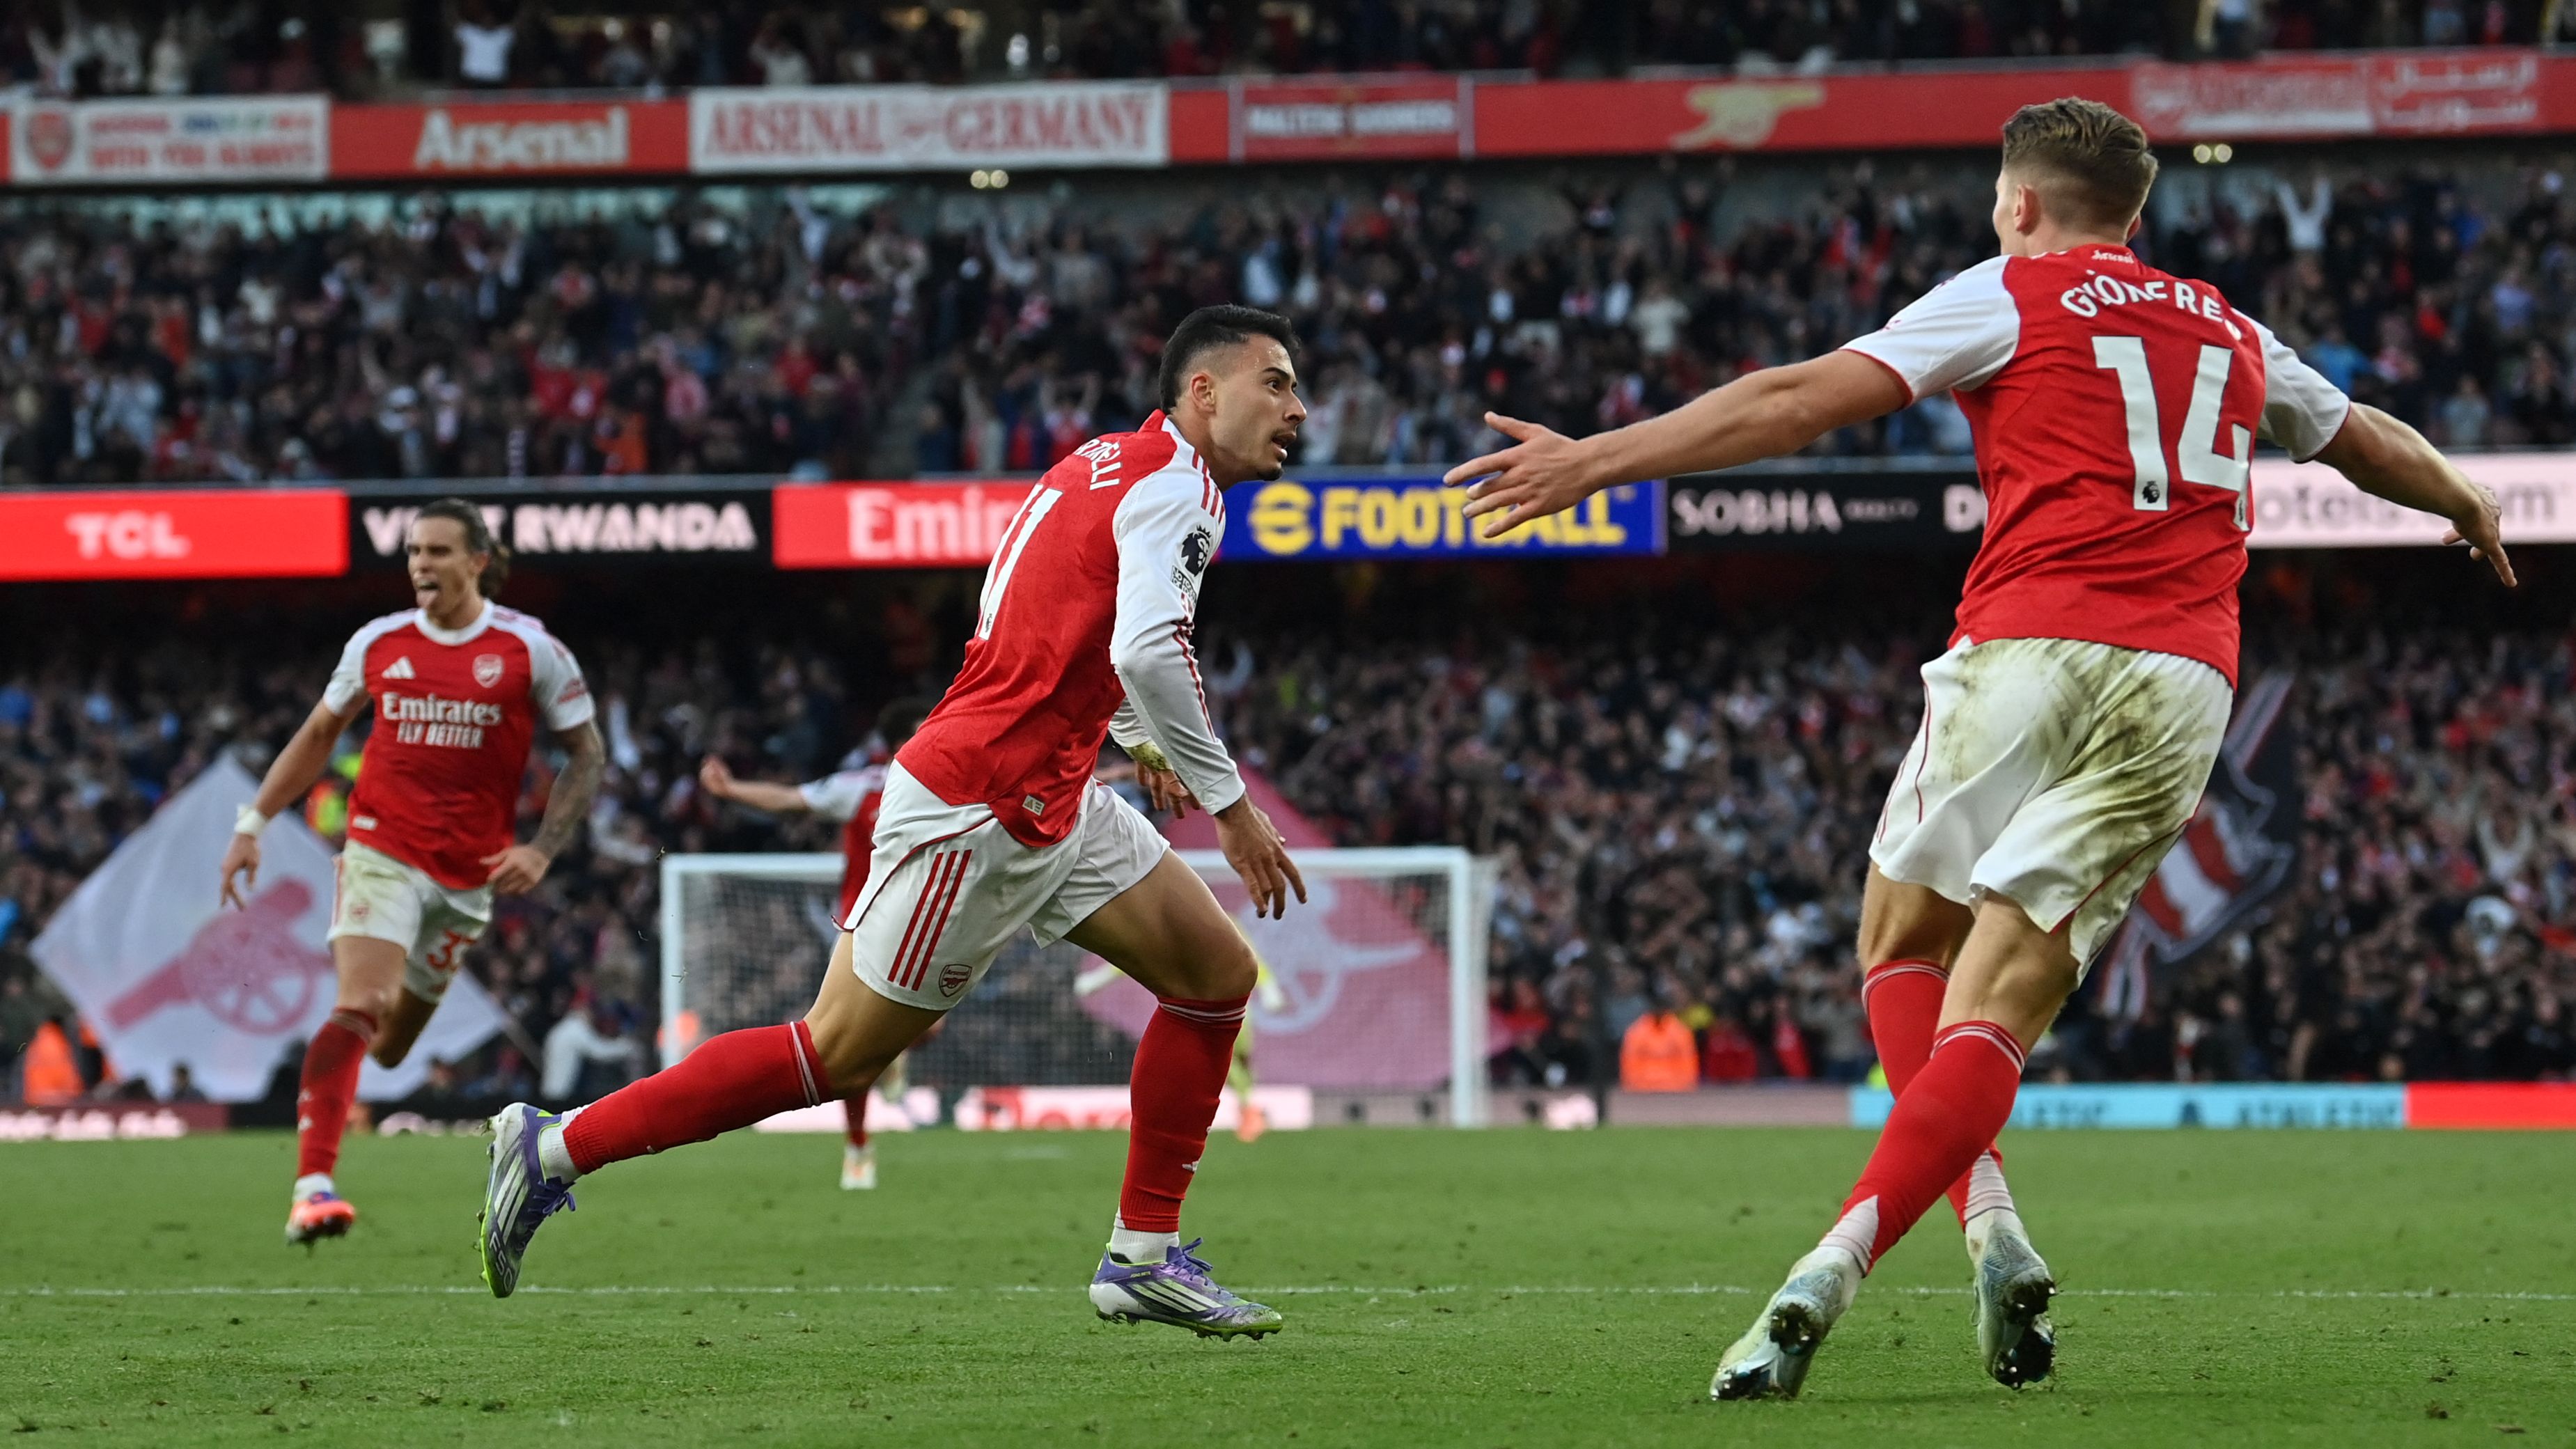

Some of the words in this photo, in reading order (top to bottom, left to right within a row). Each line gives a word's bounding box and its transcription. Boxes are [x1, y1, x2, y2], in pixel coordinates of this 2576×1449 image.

[414, 107, 629, 169] Arsenal
[706, 99, 885, 155] ARSENAL
[943, 91, 1154, 152] GERMANY
[2091, 336, 2251, 531] 14
[66, 510, 192, 558] TCL
[513, 501, 757, 554] RWANDA
[850, 486, 1022, 559] Emir
[1672, 488, 1842, 535] SOBHA
[977, 483, 1063, 641] 11
[382, 691, 501, 726] Emirates
[396, 720, 426, 744] FLY
[425, 722, 485, 749] BETTER
